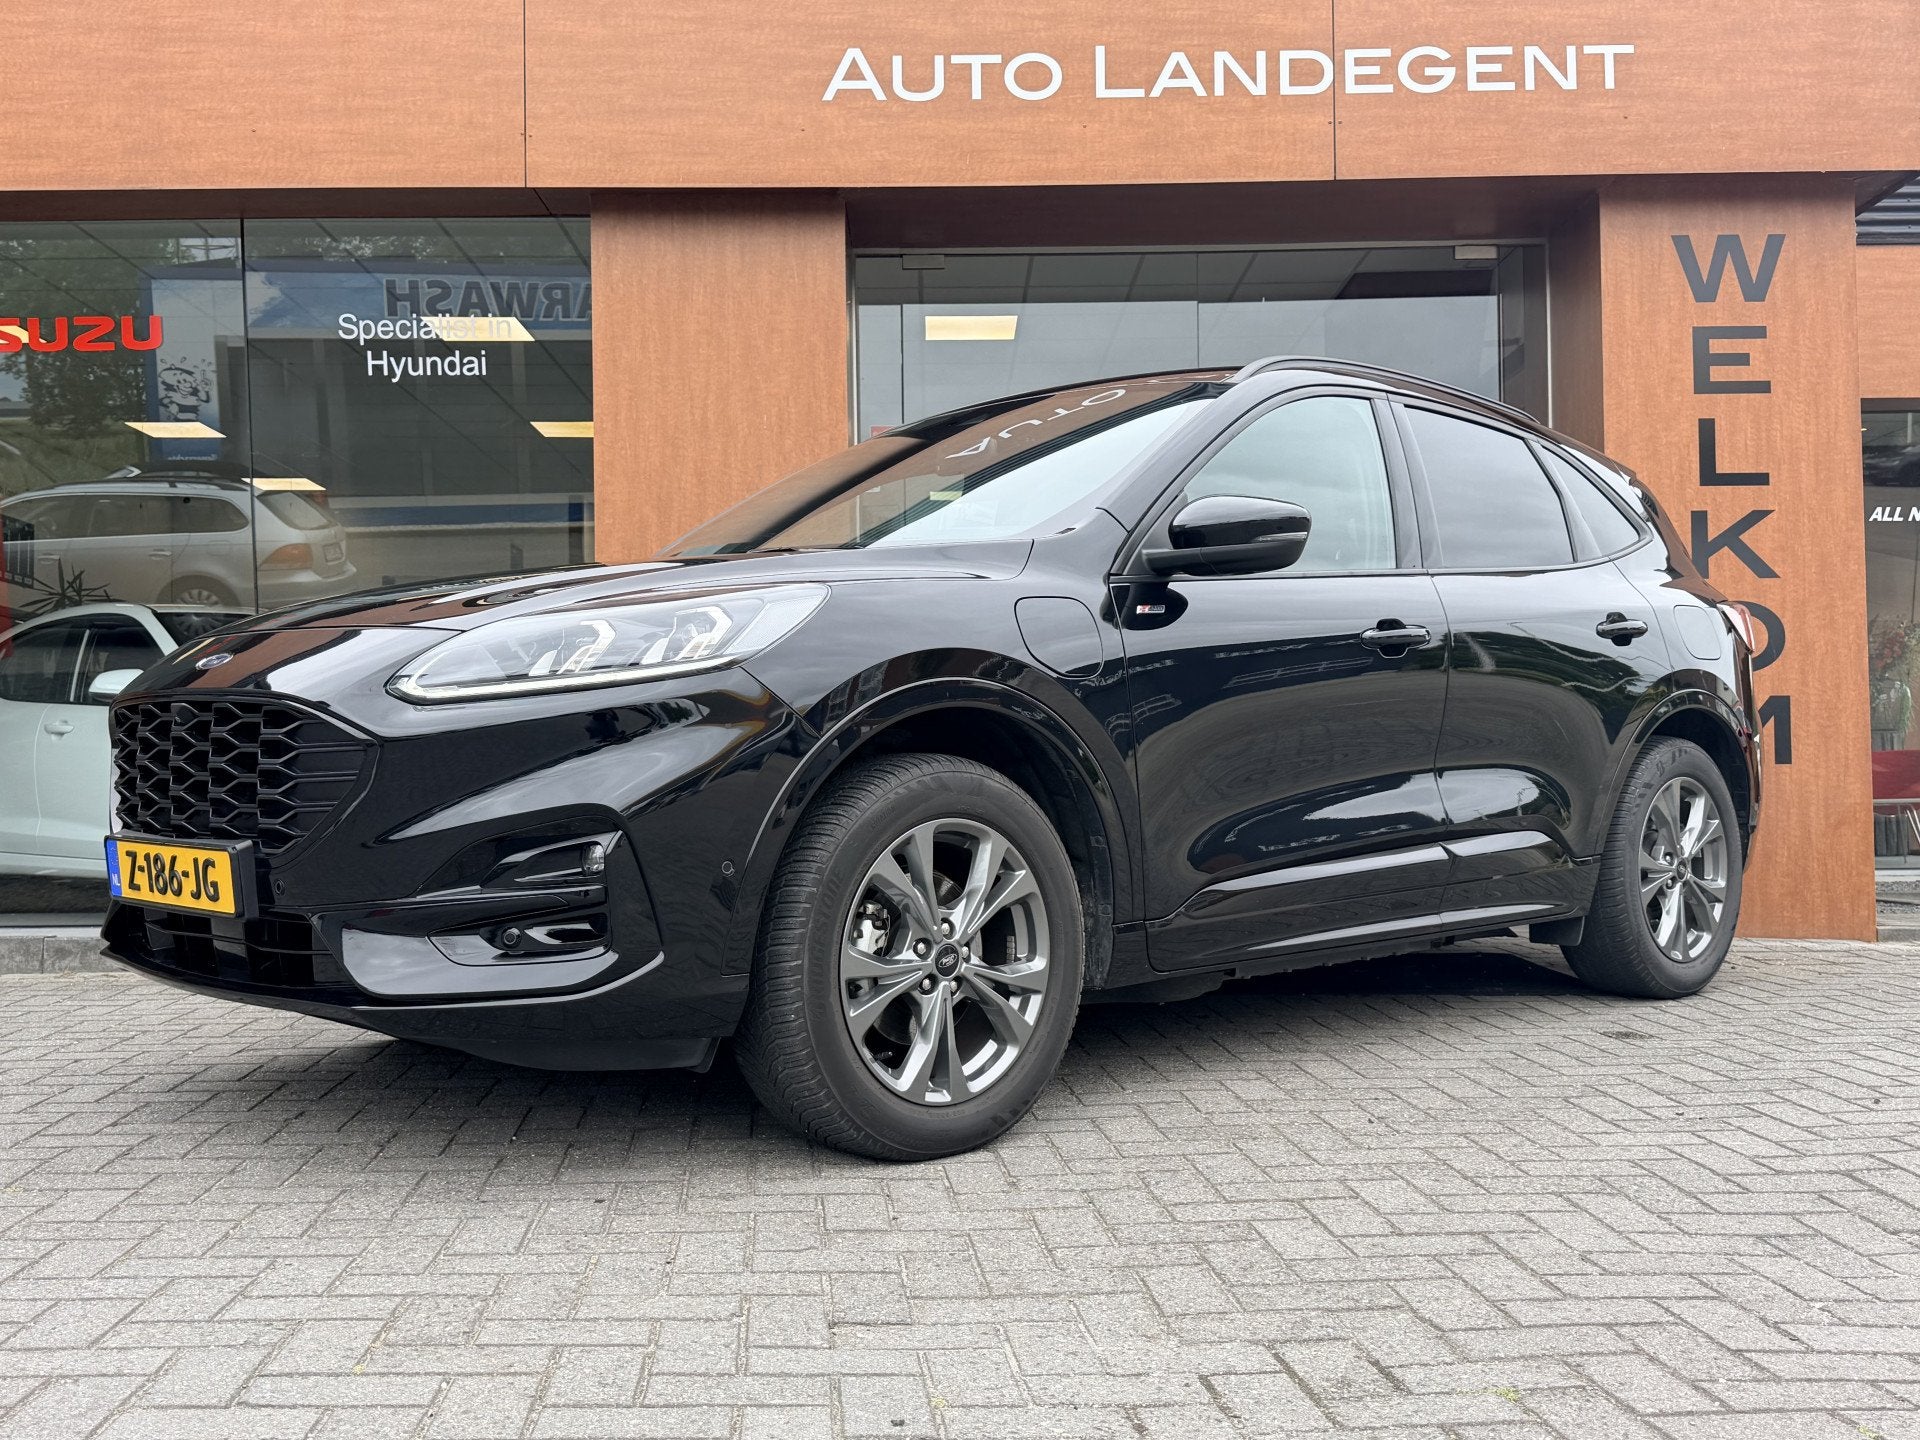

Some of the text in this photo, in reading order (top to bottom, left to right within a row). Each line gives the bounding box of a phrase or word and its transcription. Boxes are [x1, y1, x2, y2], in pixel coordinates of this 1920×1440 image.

[821, 43, 1635, 102] AUTO LANDEGENT
[337, 312, 513, 346] Specialist in
[366, 350, 488, 383] Hyundai
[1868, 506, 1904, 522] ALL
[125, 849, 221, 903] Z-186-JG
